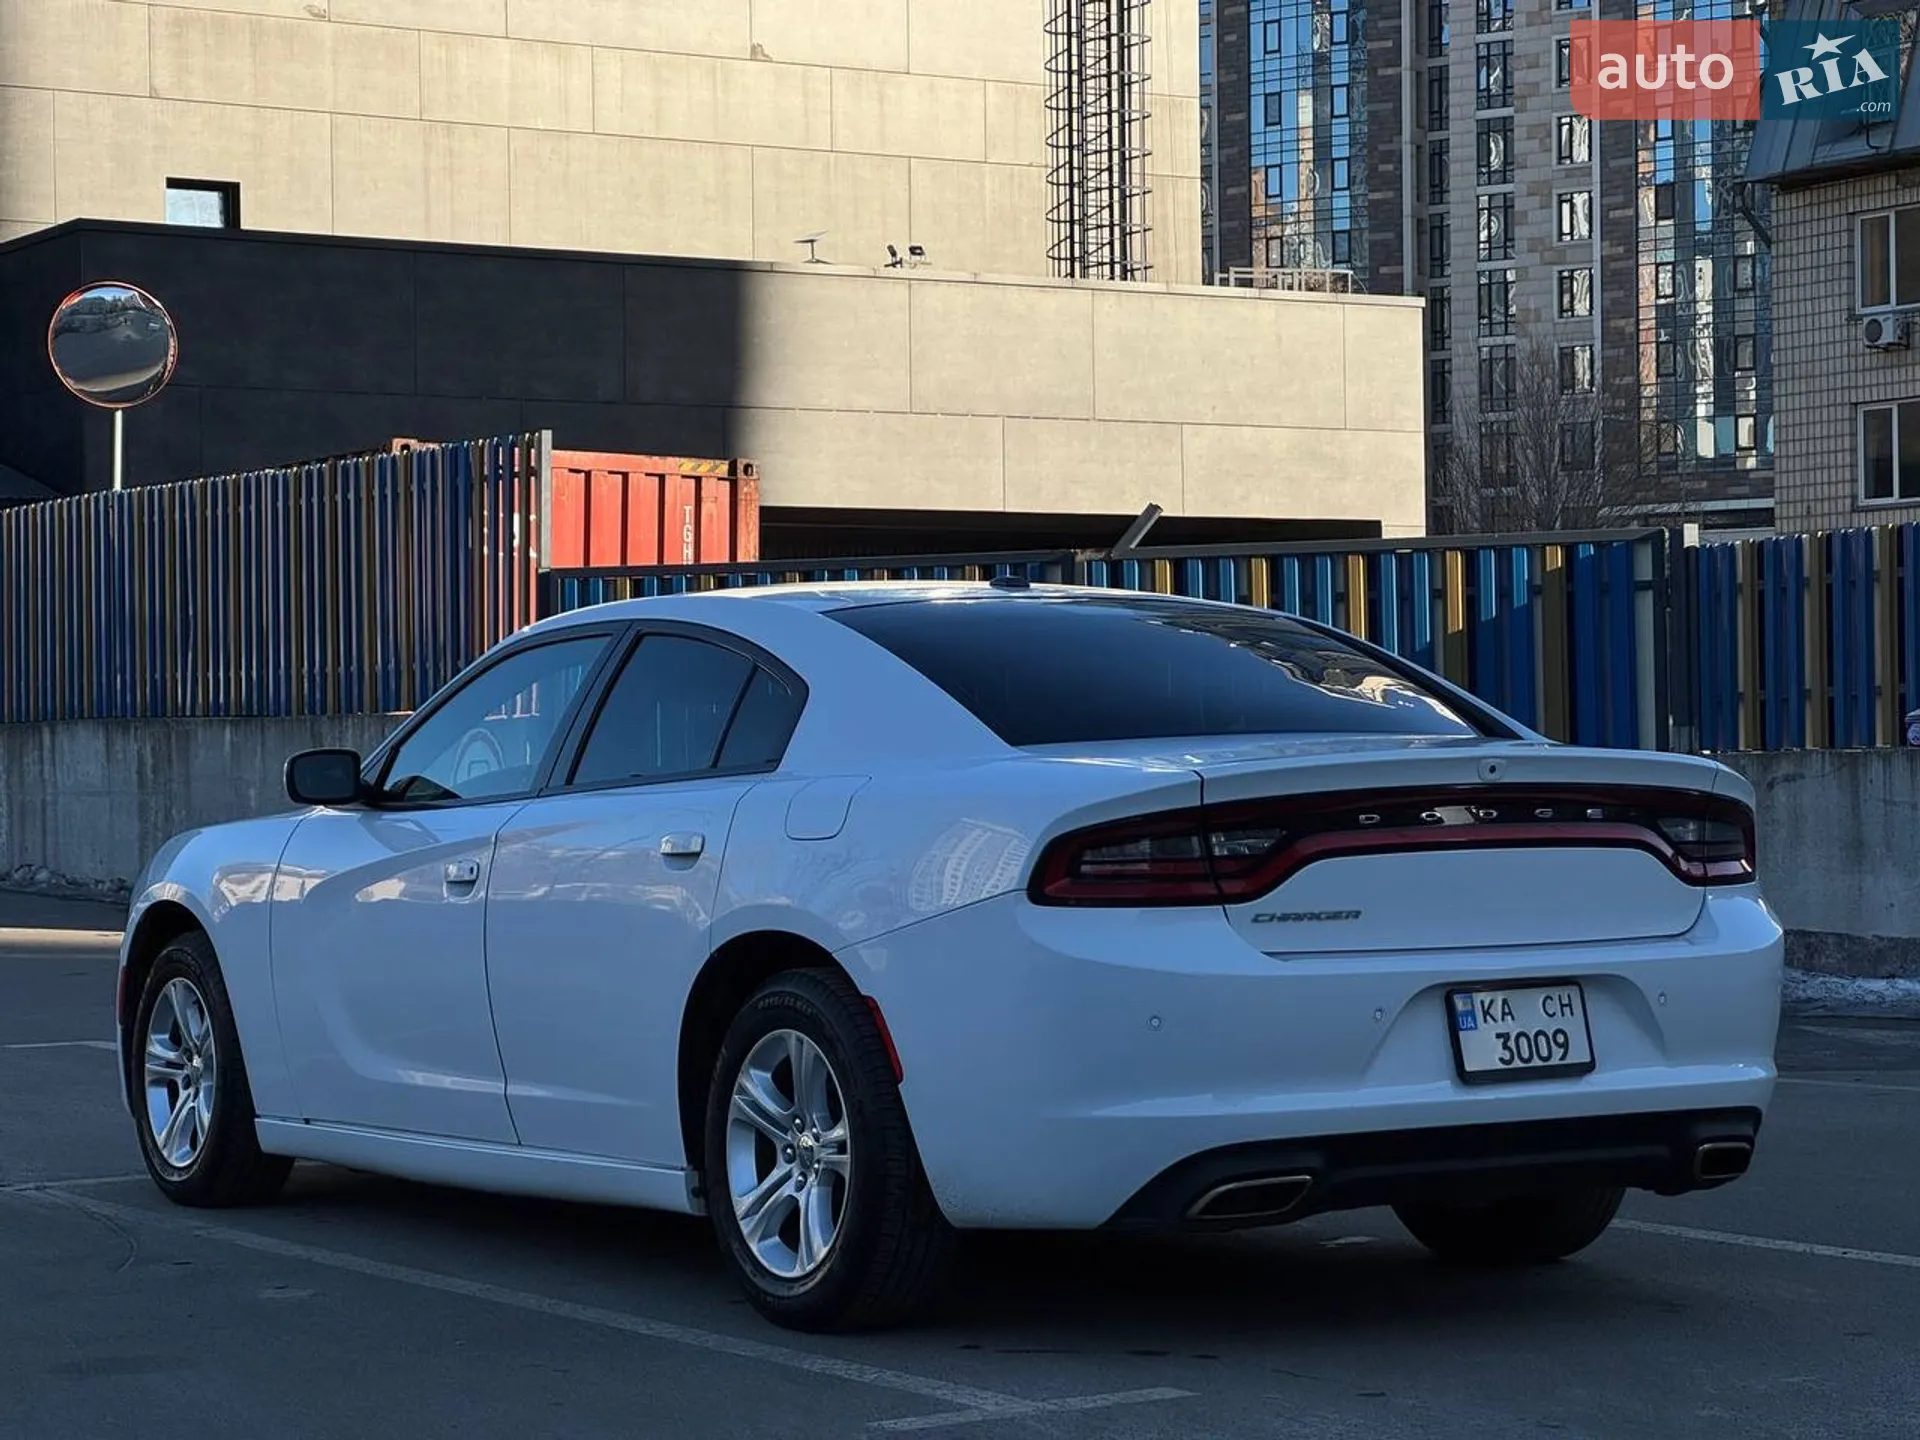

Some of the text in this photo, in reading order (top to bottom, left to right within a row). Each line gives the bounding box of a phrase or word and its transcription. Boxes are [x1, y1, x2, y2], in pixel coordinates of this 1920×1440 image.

[682, 505, 694, 566] TGH
[1358, 806, 1604, 825] DODGE
[1250, 909, 1362, 923] CHARGER
[1480, 993, 1575, 1024] KA CH
[1459, 1015, 1476, 1029] UA
[1495, 1027, 1570, 1066] 3009
